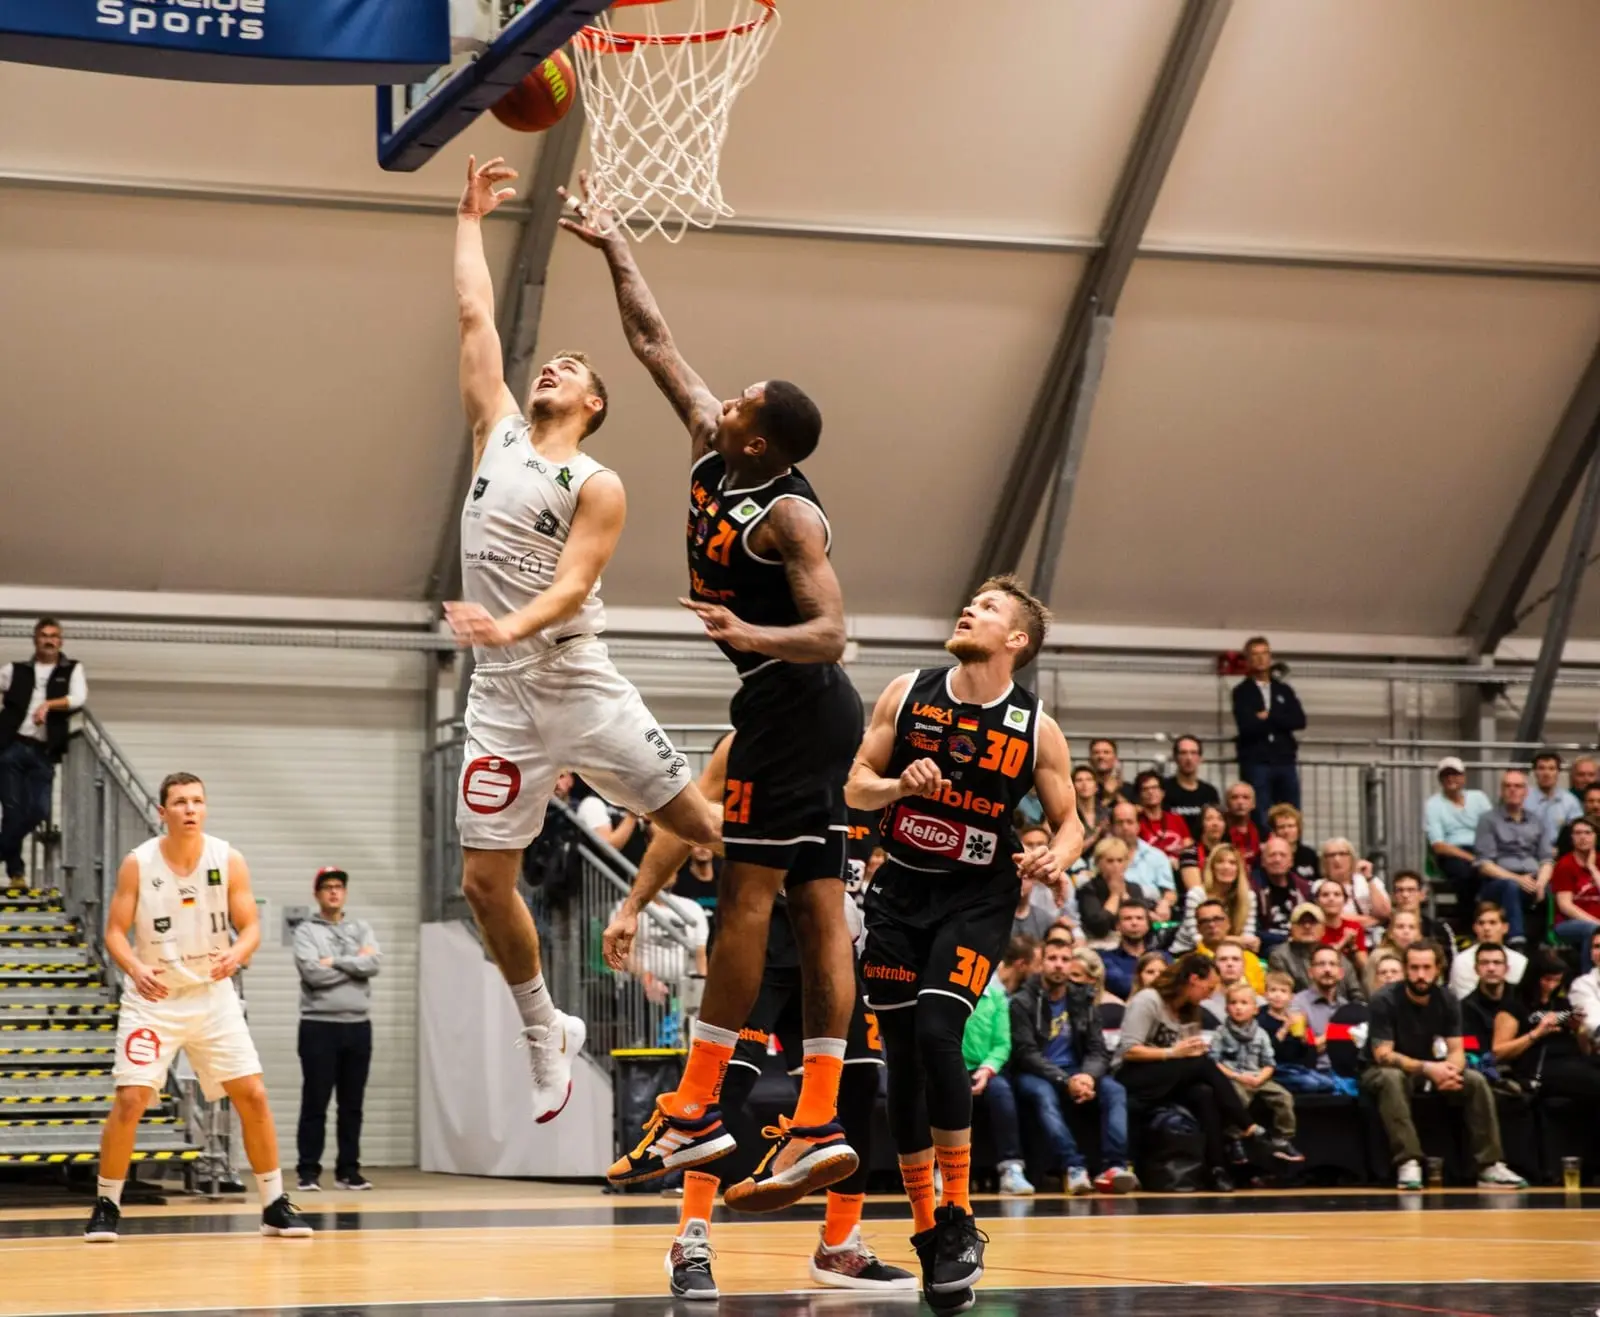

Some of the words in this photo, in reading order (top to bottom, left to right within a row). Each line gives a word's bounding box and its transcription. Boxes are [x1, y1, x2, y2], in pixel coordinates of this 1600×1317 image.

[96, 0, 264, 40] Sports
[978, 729, 1029, 779] 30
[724, 778, 753, 824] 21
[899, 816, 960, 848] Helios
[949, 945, 991, 998] 30
